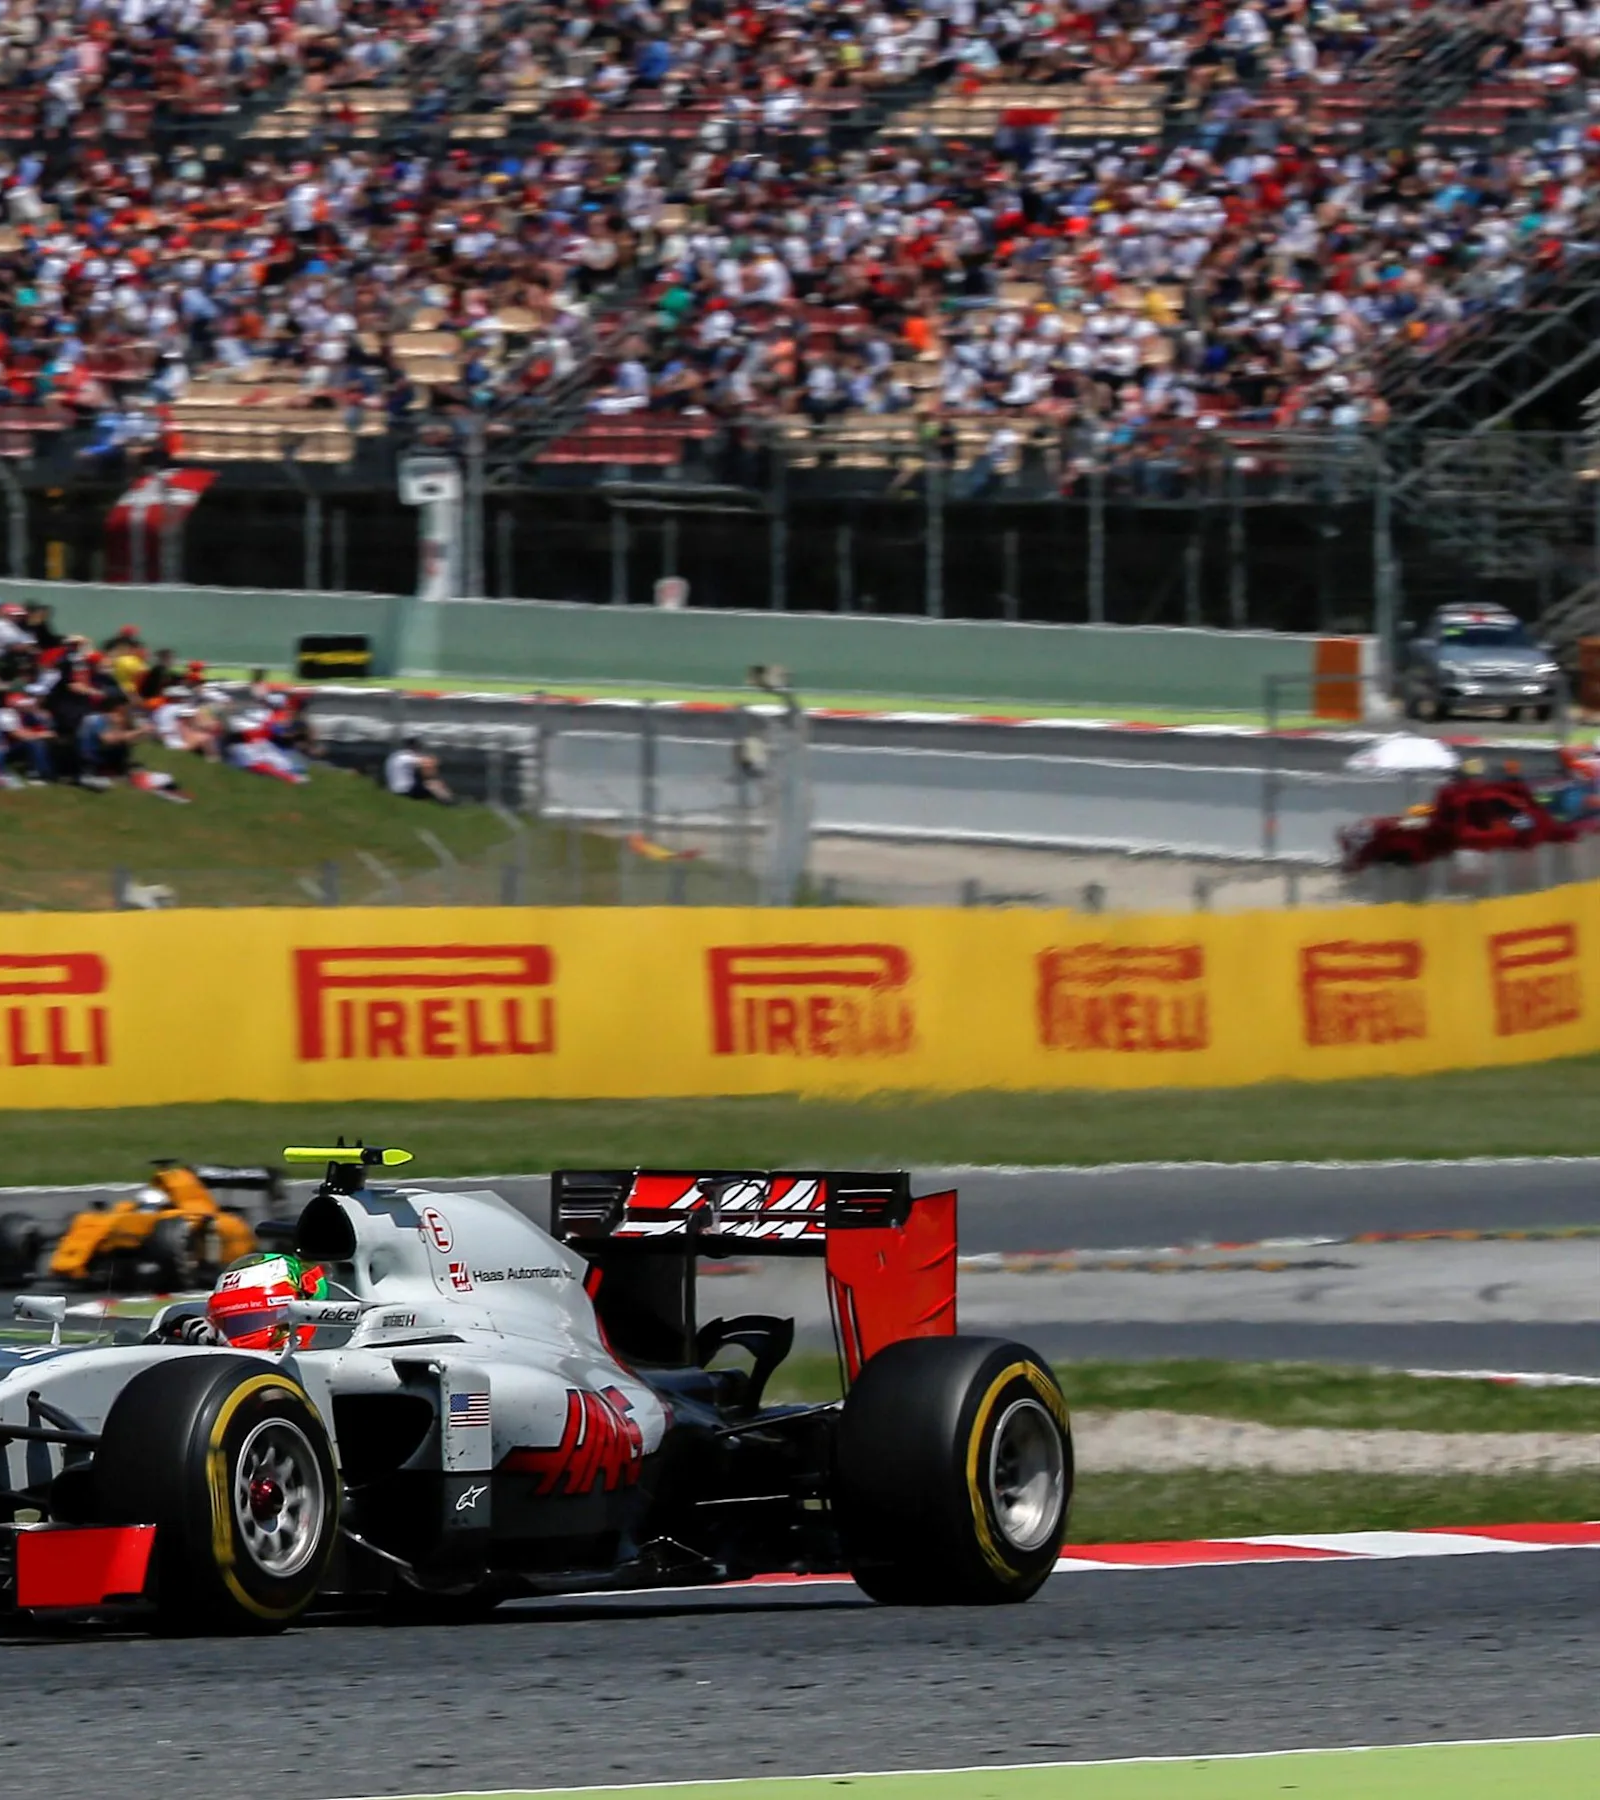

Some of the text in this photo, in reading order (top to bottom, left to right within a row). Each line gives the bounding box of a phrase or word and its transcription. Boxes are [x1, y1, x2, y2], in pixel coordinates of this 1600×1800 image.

[293, 944, 555, 1061] PIRELLI
[428, 1213, 449, 1246] E
[473, 1270, 504, 1283] Haas
[507, 1267, 563, 1281] Automation
[318, 1309, 360, 1321] telcel
[498, 1384, 643, 1495] HAAS
